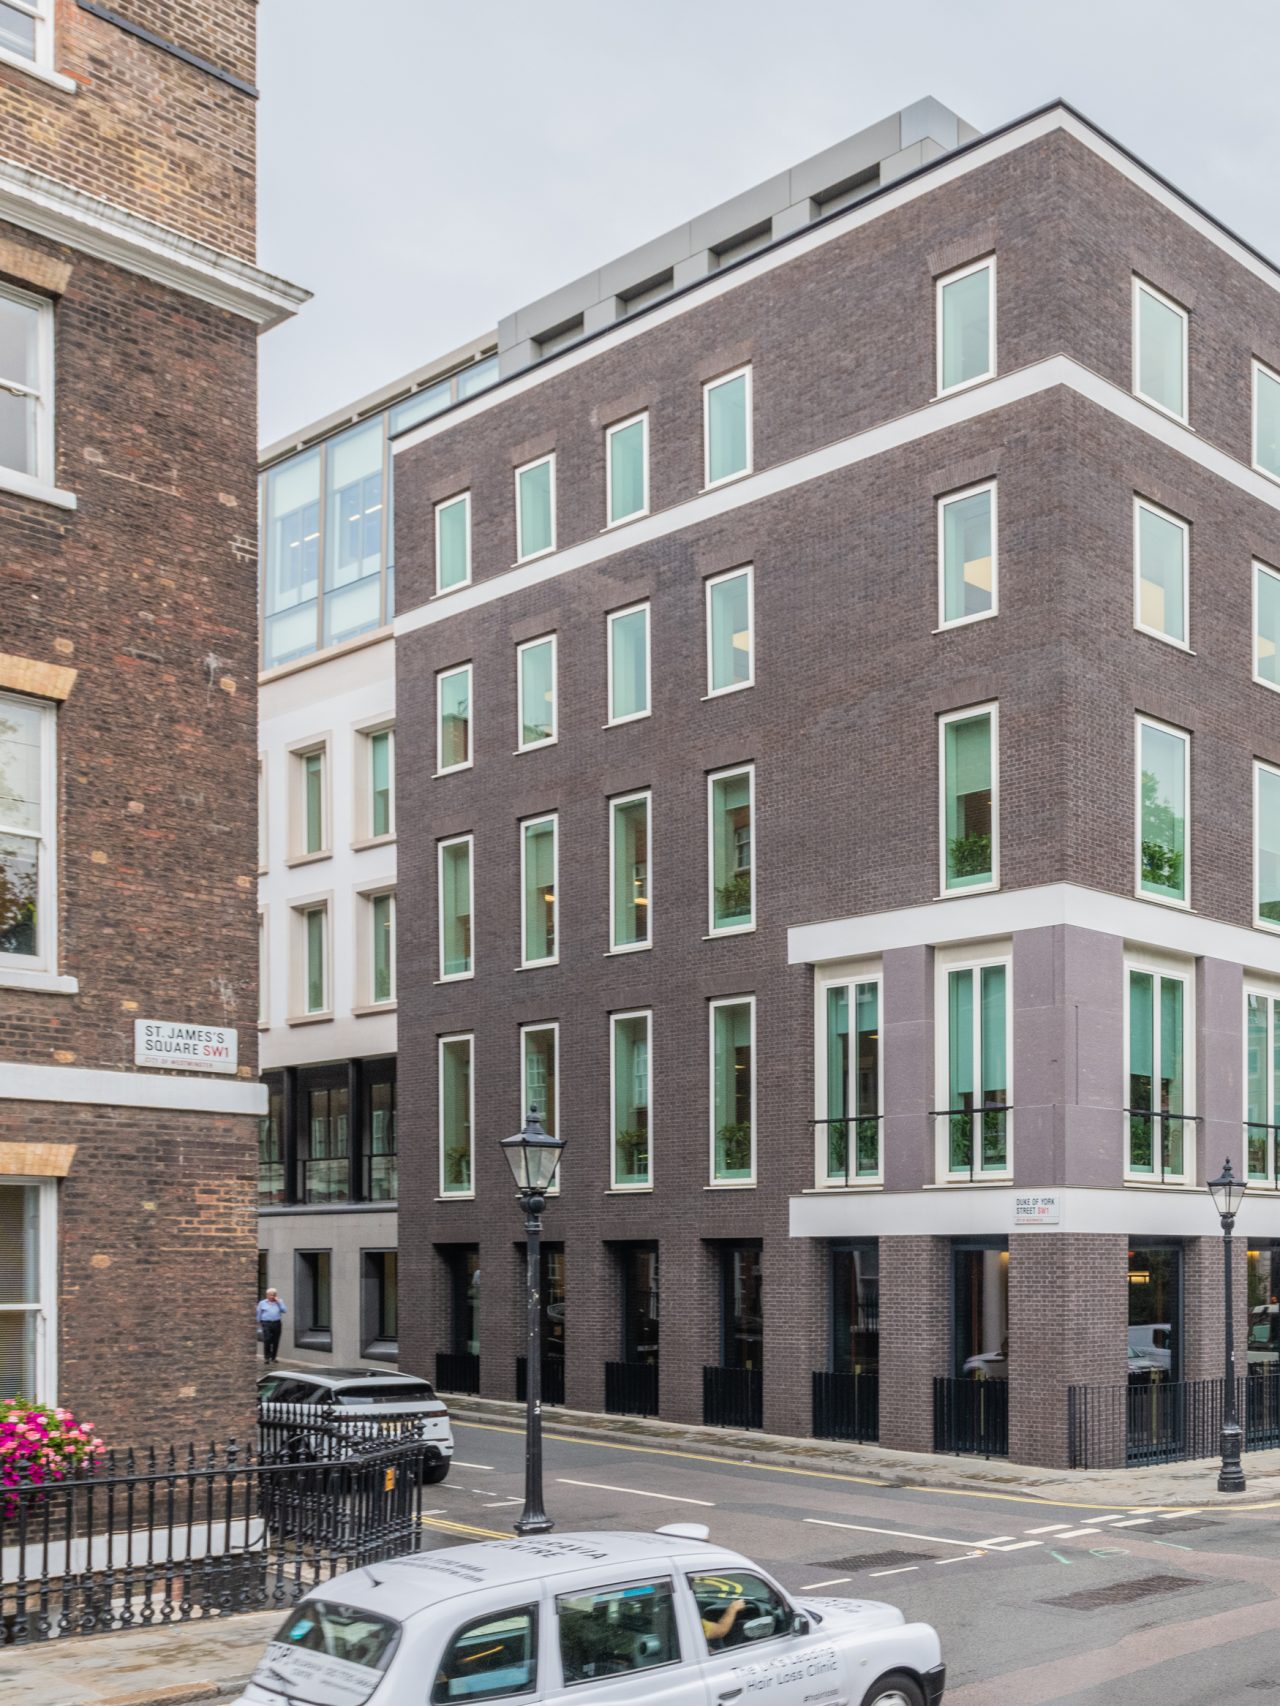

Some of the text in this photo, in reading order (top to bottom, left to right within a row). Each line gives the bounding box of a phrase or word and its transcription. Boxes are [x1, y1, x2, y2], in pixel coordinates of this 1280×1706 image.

[145, 1025, 225, 1044] ST. JAMES'S
[145, 1039, 229, 1058] SQUARE SW1
[1016, 1206, 1049, 1214] STREET SW1
[1041, 1197, 1056, 1206] YORK
[515, 1538, 609, 1560] GRAVIA
[789, 1646, 837, 1666] Leading
[745, 1660, 839, 1693] Hair Loss Clinic
